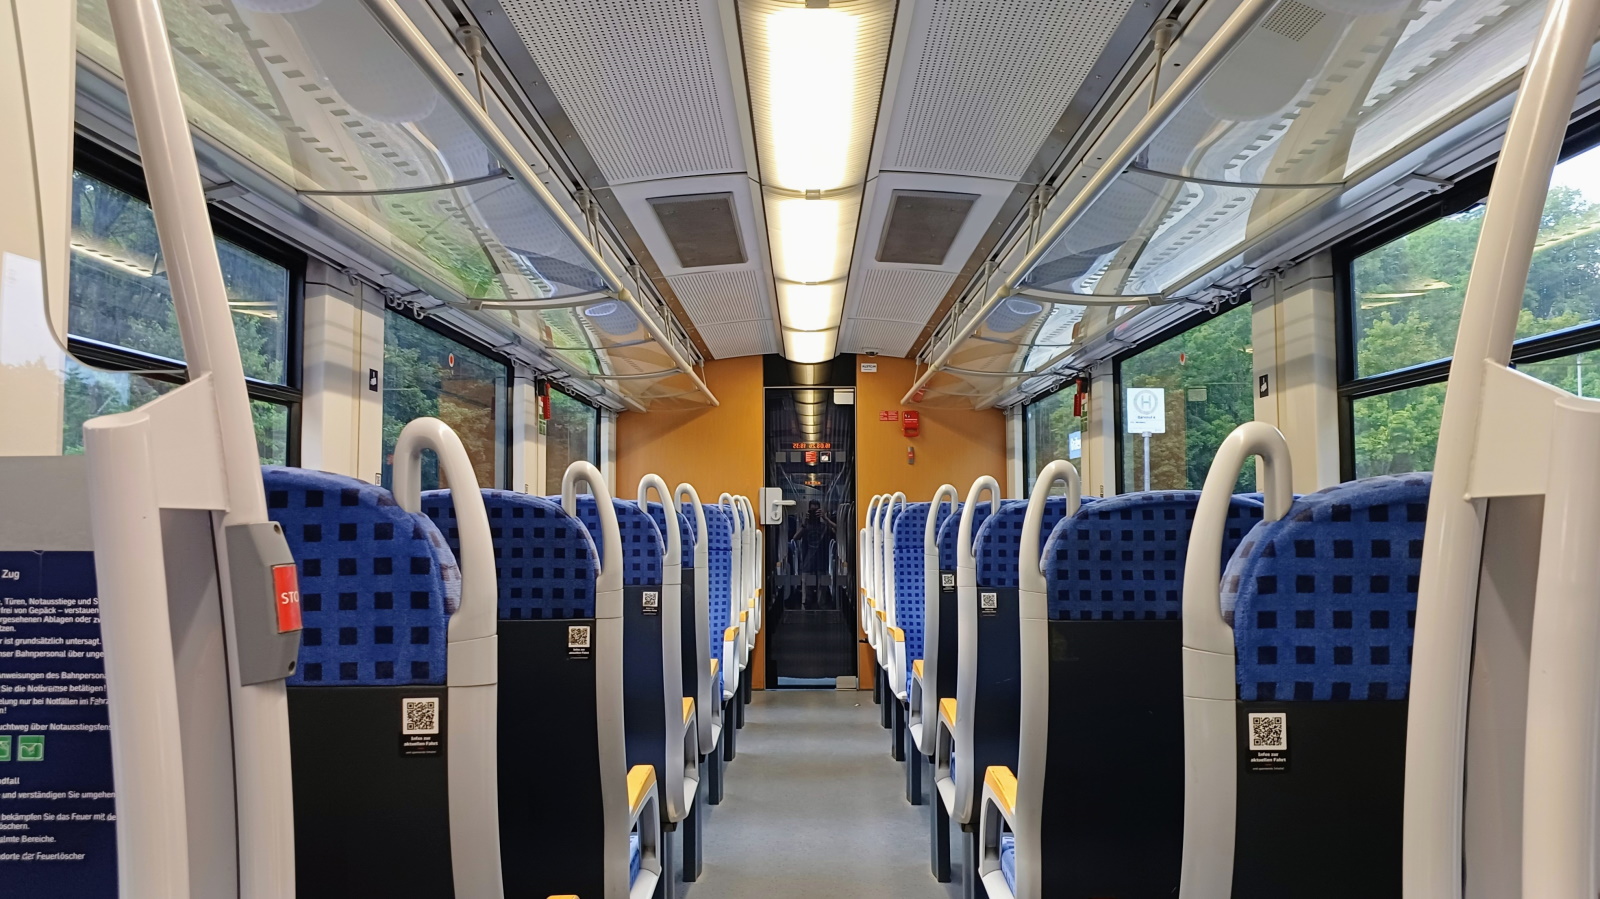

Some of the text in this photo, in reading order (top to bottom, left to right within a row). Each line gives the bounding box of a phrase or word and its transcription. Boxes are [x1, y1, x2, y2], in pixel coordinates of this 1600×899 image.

[1, 569, 20, 580] Zug
[4, 597, 27, 606] Türen,
[29, 598, 76, 607] Notausstiege
[281, 591, 299, 604] STO
[29, 607, 56, 615] Gepäck
[43, 616, 73, 624] Ablagen
[4, 637, 14, 645] ist
[15, 637, 64, 646] grundsätzlich
[65, 638, 101, 646] untersagt.
[15, 650, 66, 658] Bahnpersonal
[68, 650, 85, 658] über
[86, 651, 104, 659] unge
[69, 684, 107, 693] betätigen!
[80, 697, 89, 705] im
[31, 723, 48, 731] über
[2, 791, 116, 800] und verständigen Sie umgehen
[2, 813, 42, 822] bekämpfen
[43, 813, 55, 821] Sie
[57, 813, 70, 821] das
[72, 813, 92, 821] Feuer
[93, 813, 106, 821] mit
[21, 835, 56, 843] Bereiche.
[22, 852, 35, 860] der
[37, 852, 85, 860] Feuerlöscher
